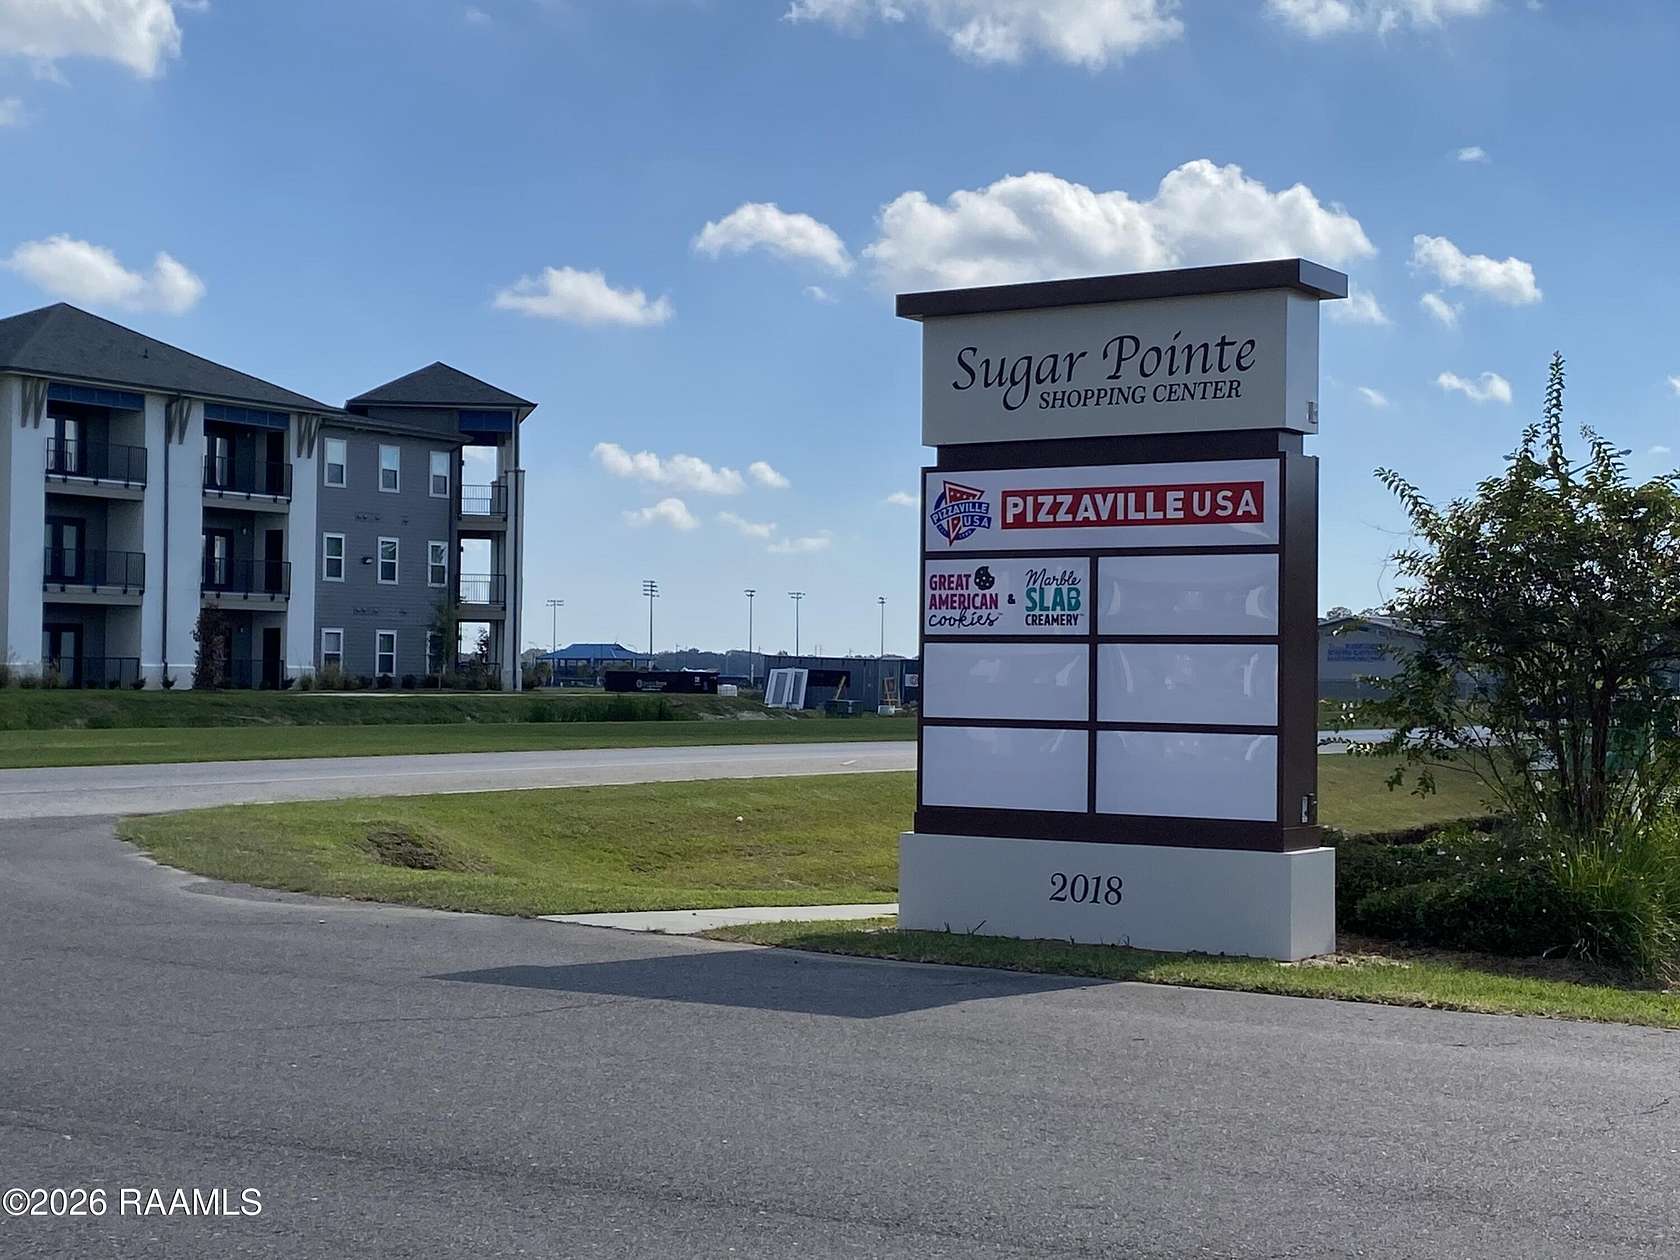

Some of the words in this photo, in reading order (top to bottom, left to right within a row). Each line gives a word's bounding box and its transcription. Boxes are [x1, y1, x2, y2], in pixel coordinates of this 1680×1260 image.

[952, 346, 1088, 411] Sugar
[1102, 330, 1257, 381] Pointe
[1039, 385, 1146, 410] SHOPPING
[1152, 379, 1242, 403] CENTER
[931, 503, 988, 524] PIZZAVILLE
[1005, 491, 1185, 524] PIZZAVILLE
[1192, 489, 1258, 517] USA
[964, 516, 990, 528] USA
[929, 574, 971, 591] GREAT
[1025, 568, 1081, 588] Marble
[929, 593, 999, 610] AMERICAN
[1007, 593, 1016, 605] &
[1025, 587, 1081, 612] SLAB
[928, 607, 1000, 628] cookies
[1025, 613, 1079, 626] CREAMERY
[1049, 873, 1123, 905] 2018
